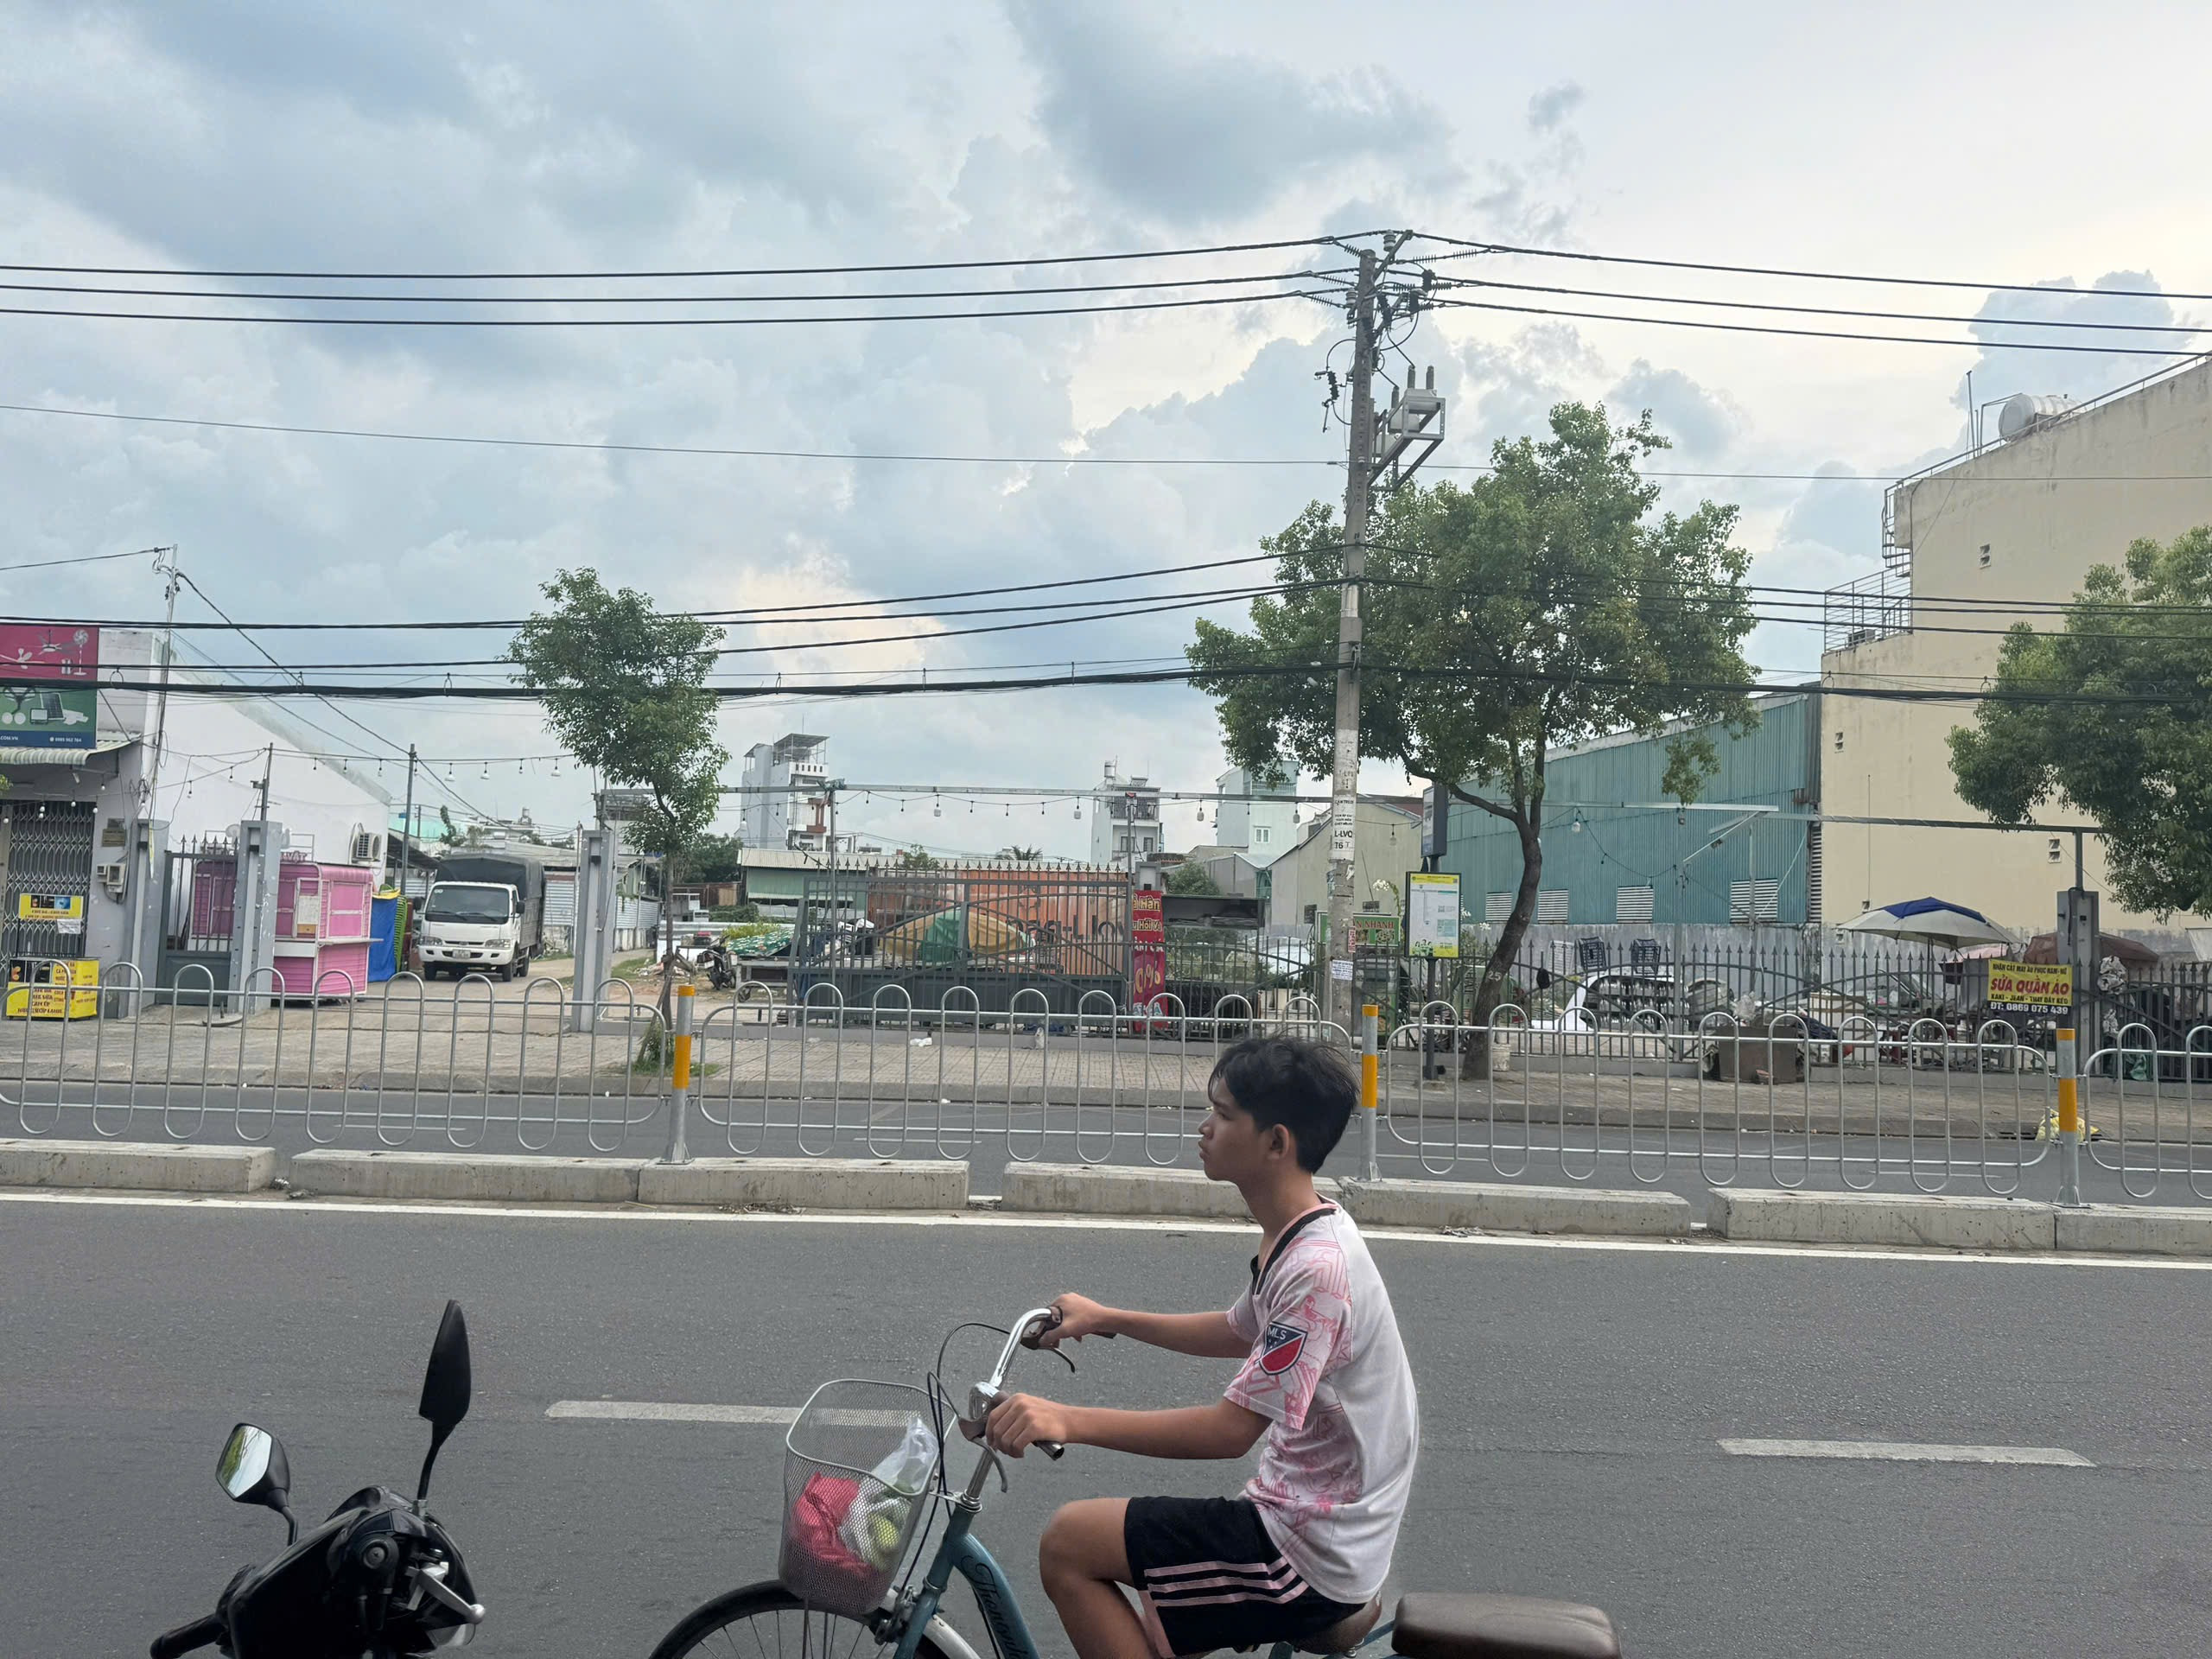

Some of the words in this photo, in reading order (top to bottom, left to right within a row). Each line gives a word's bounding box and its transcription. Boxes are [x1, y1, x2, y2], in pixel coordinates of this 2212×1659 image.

[1365, 920, 1394, 929] NHANH
[1488, 970, 1502, 982] 25
[1991, 974, 2012, 993] SỬA
[2016, 975, 2050, 995] QUẦN
[2051, 978, 2070, 995] ÁO
[2006, 1003, 2029, 1012] 0869
[2031, 1004, 2049, 1014] 075
[2050, 1006, 2069, 1014] 439
[1267, 1326, 1287, 1340] MLS
